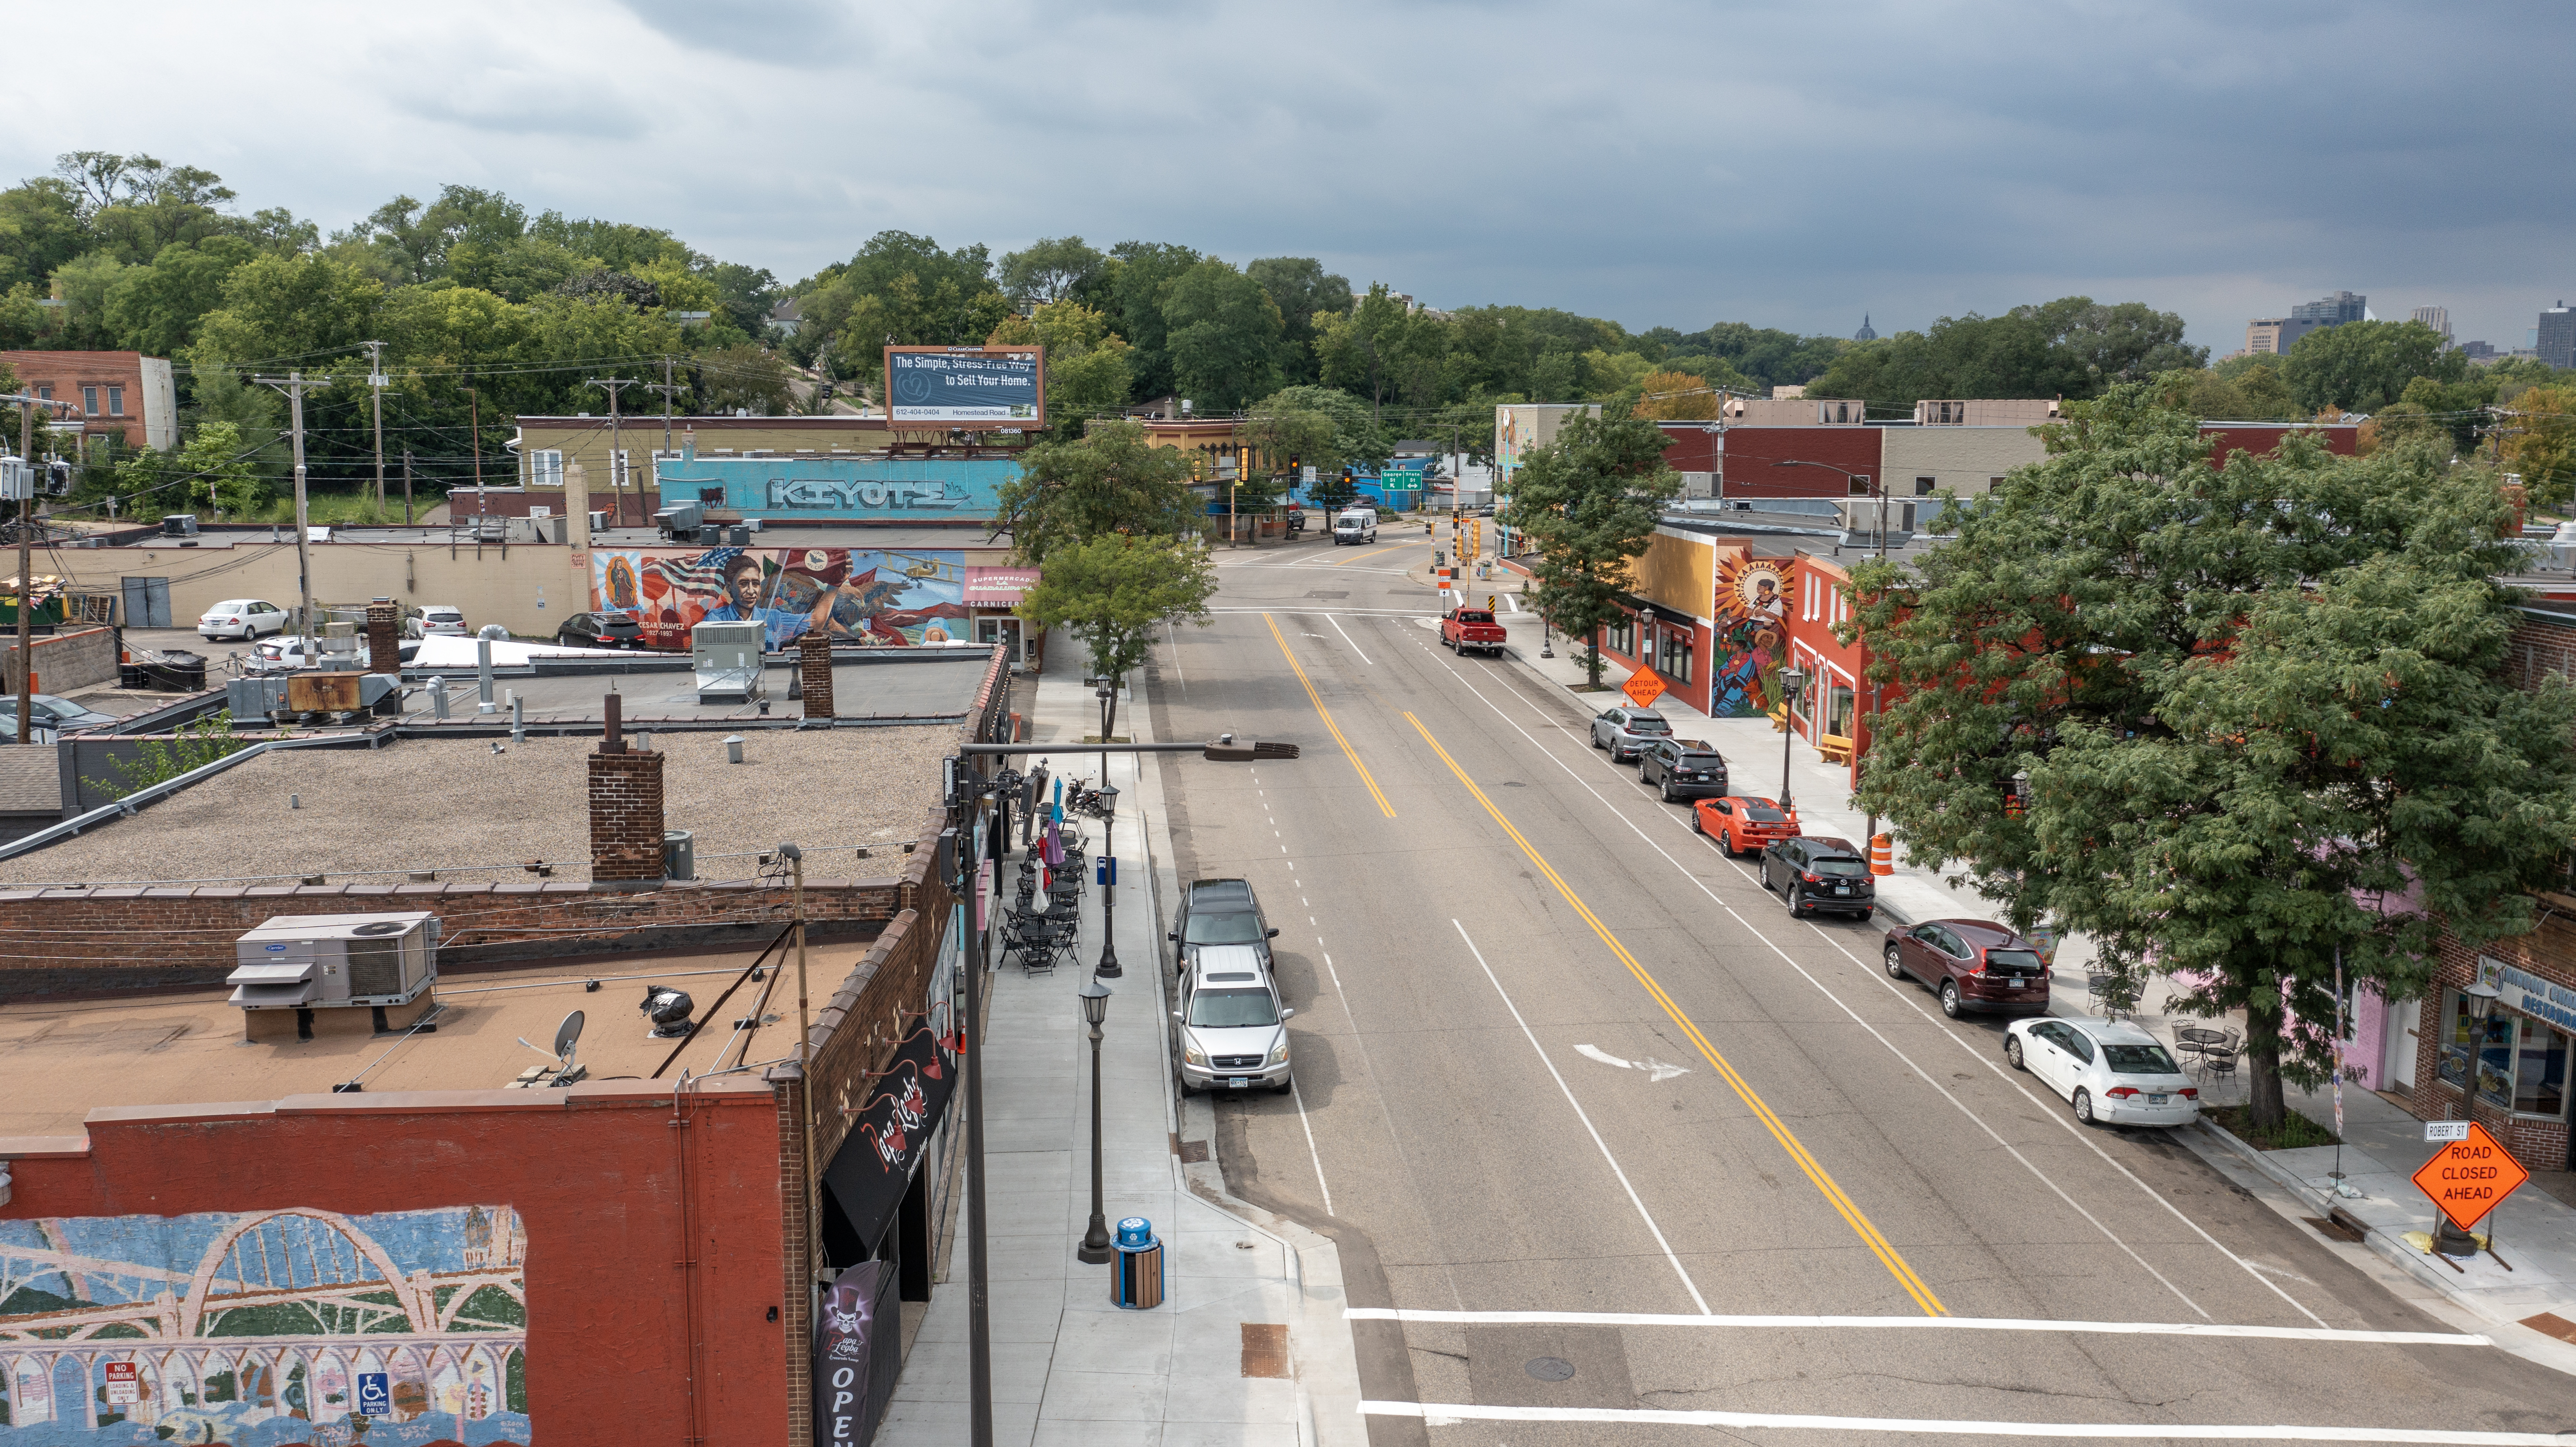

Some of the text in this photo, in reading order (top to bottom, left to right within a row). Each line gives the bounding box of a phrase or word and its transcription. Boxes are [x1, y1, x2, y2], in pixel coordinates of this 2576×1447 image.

[896, 356, 913, 368] The
[915, 356, 950, 370] Simple,
[1009, 362, 1031, 372] Way
[946, 375, 1031, 386] to Sell Your Home.
[660, 622, 685, 631] CHAVEZ
[2504, 967, 2546, 996] RINCON
[2429, 1126, 2465, 1137] ROBERT ST
[2452, 1146, 2491, 1159] ROAD
[2442, 1167, 2497, 1180] CLOSED
[2444, 1187, 2493, 1200] AHEAD
[826, 1331, 858, 1351] Papa
[832, 1341, 859, 1356] Legba
[108, 1372, 134, 1380] PARKING
[832, 1367, 854, 1447] OPE
